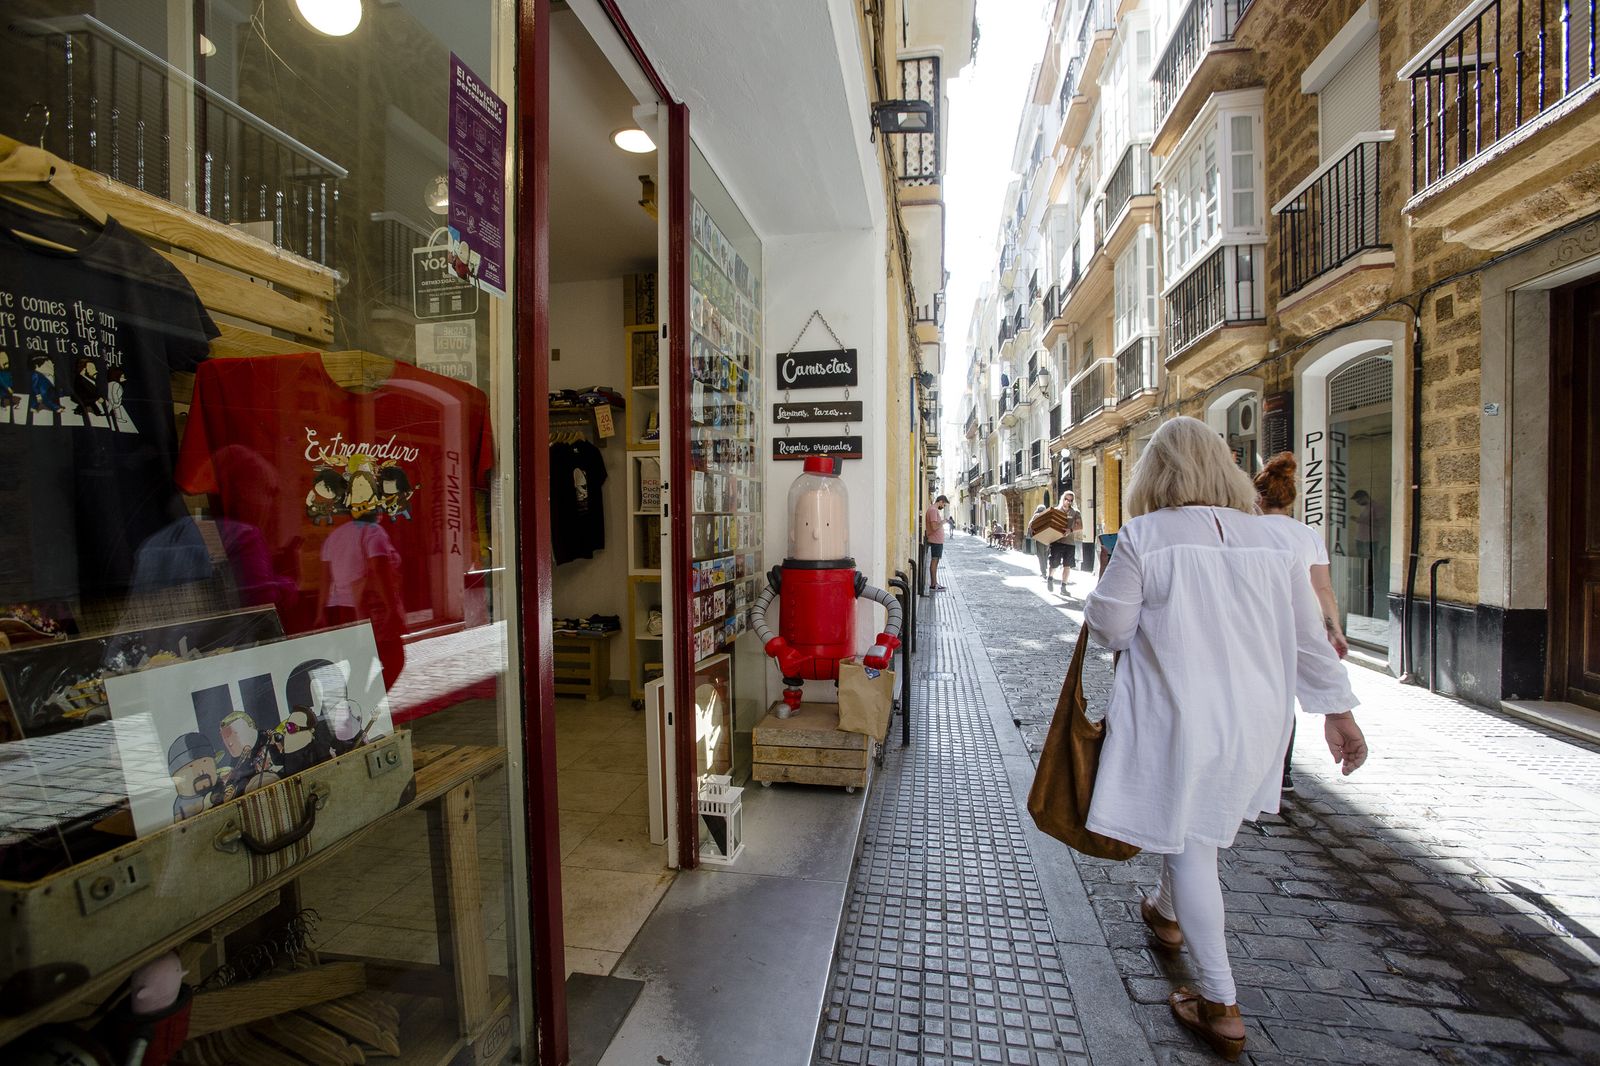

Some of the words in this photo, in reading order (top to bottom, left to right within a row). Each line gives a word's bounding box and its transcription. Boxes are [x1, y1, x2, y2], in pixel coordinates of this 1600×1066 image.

[456, 65, 465, 81] El
[456, 78, 502, 124] personalizado
[21, 296, 67, 316] comes
[73, 300, 95, 325] the
[23, 316, 69, 335] comes
[76, 319, 97, 342] the
[13, 330, 20, 348] I
[26, 335, 49, 354] say
[83, 340, 101, 358] all
[782, 357, 853, 384] Camisetas
[304, 426, 420, 462] Extremoduro
[778, 440, 811, 454] Regalos
[813, 441, 853, 453] originales
